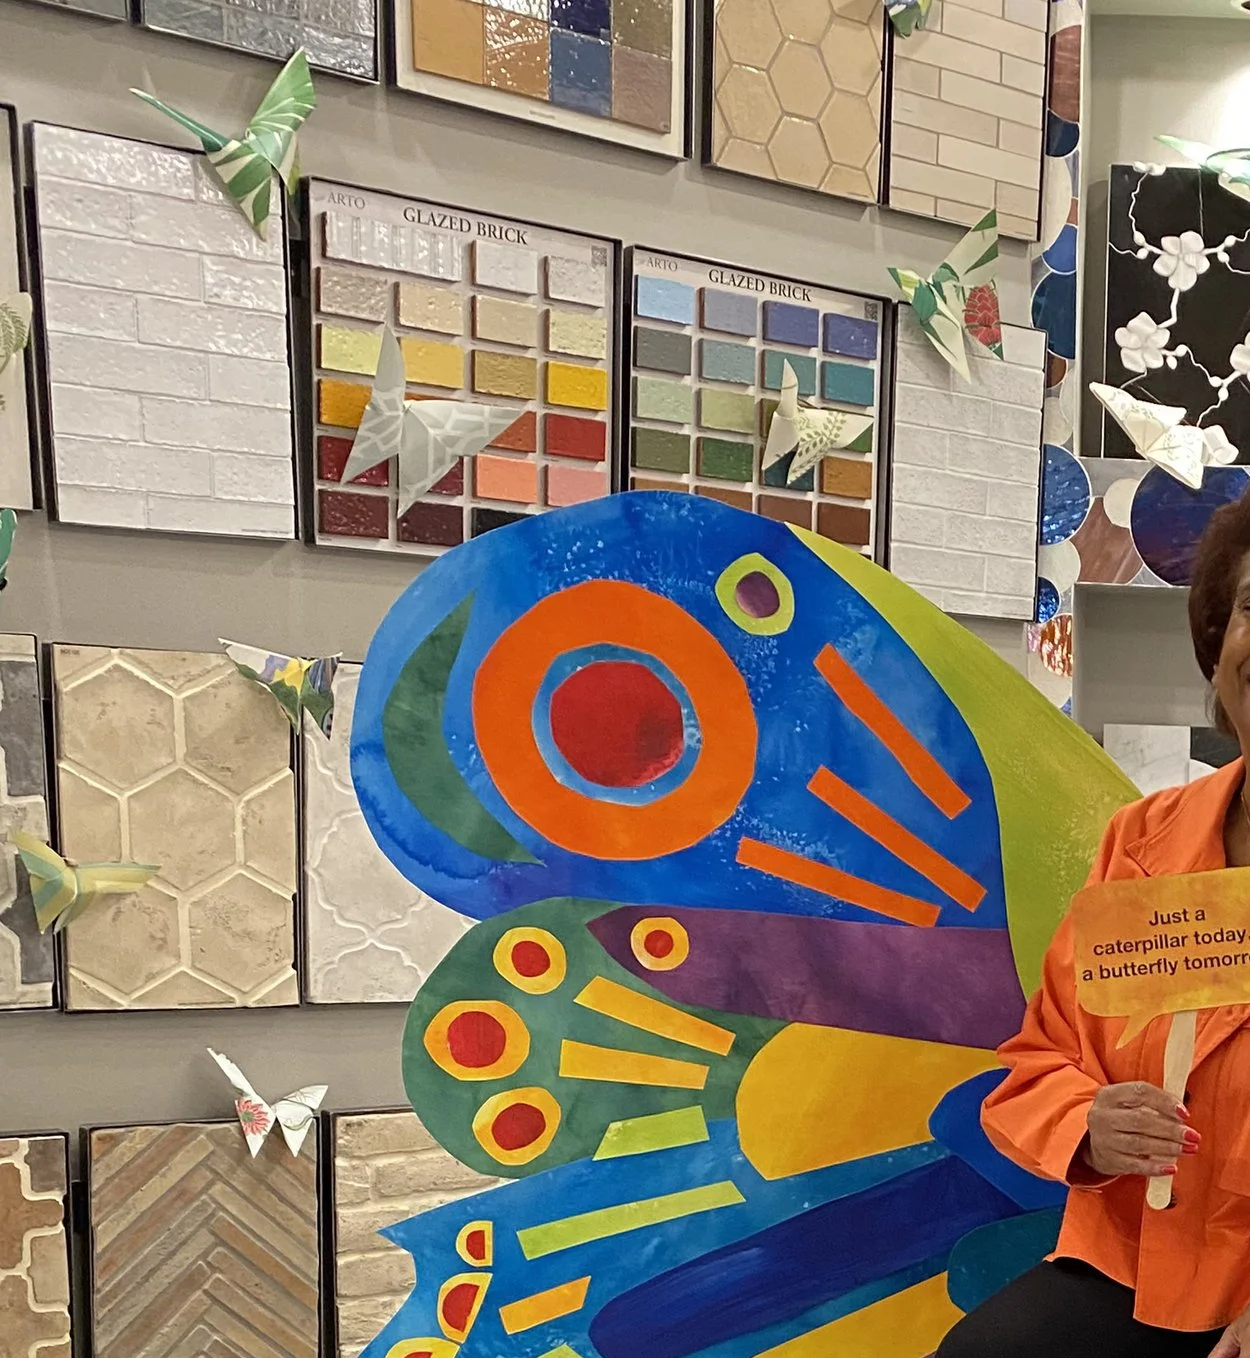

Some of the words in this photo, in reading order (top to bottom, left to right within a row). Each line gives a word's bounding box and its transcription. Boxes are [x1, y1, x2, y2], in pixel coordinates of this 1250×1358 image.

[328, 191, 366, 210] ARTO
[403, 206, 472, 234] GLAZED
[477, 221, 529, 246] BRICK
[647, 256, 678, 272] ARTO
[708, 269, 766, 293] GLAZED
[769, 282, 812, 302] BRICK
[1149, 908, 1190, 927] Just
[1194, 909, 1206, 921] a
[1093, 932, 1188, 956] caterpillar
[1082, 969, 1094, 982] a
[1099, 957, 1179, 980] butterfly
